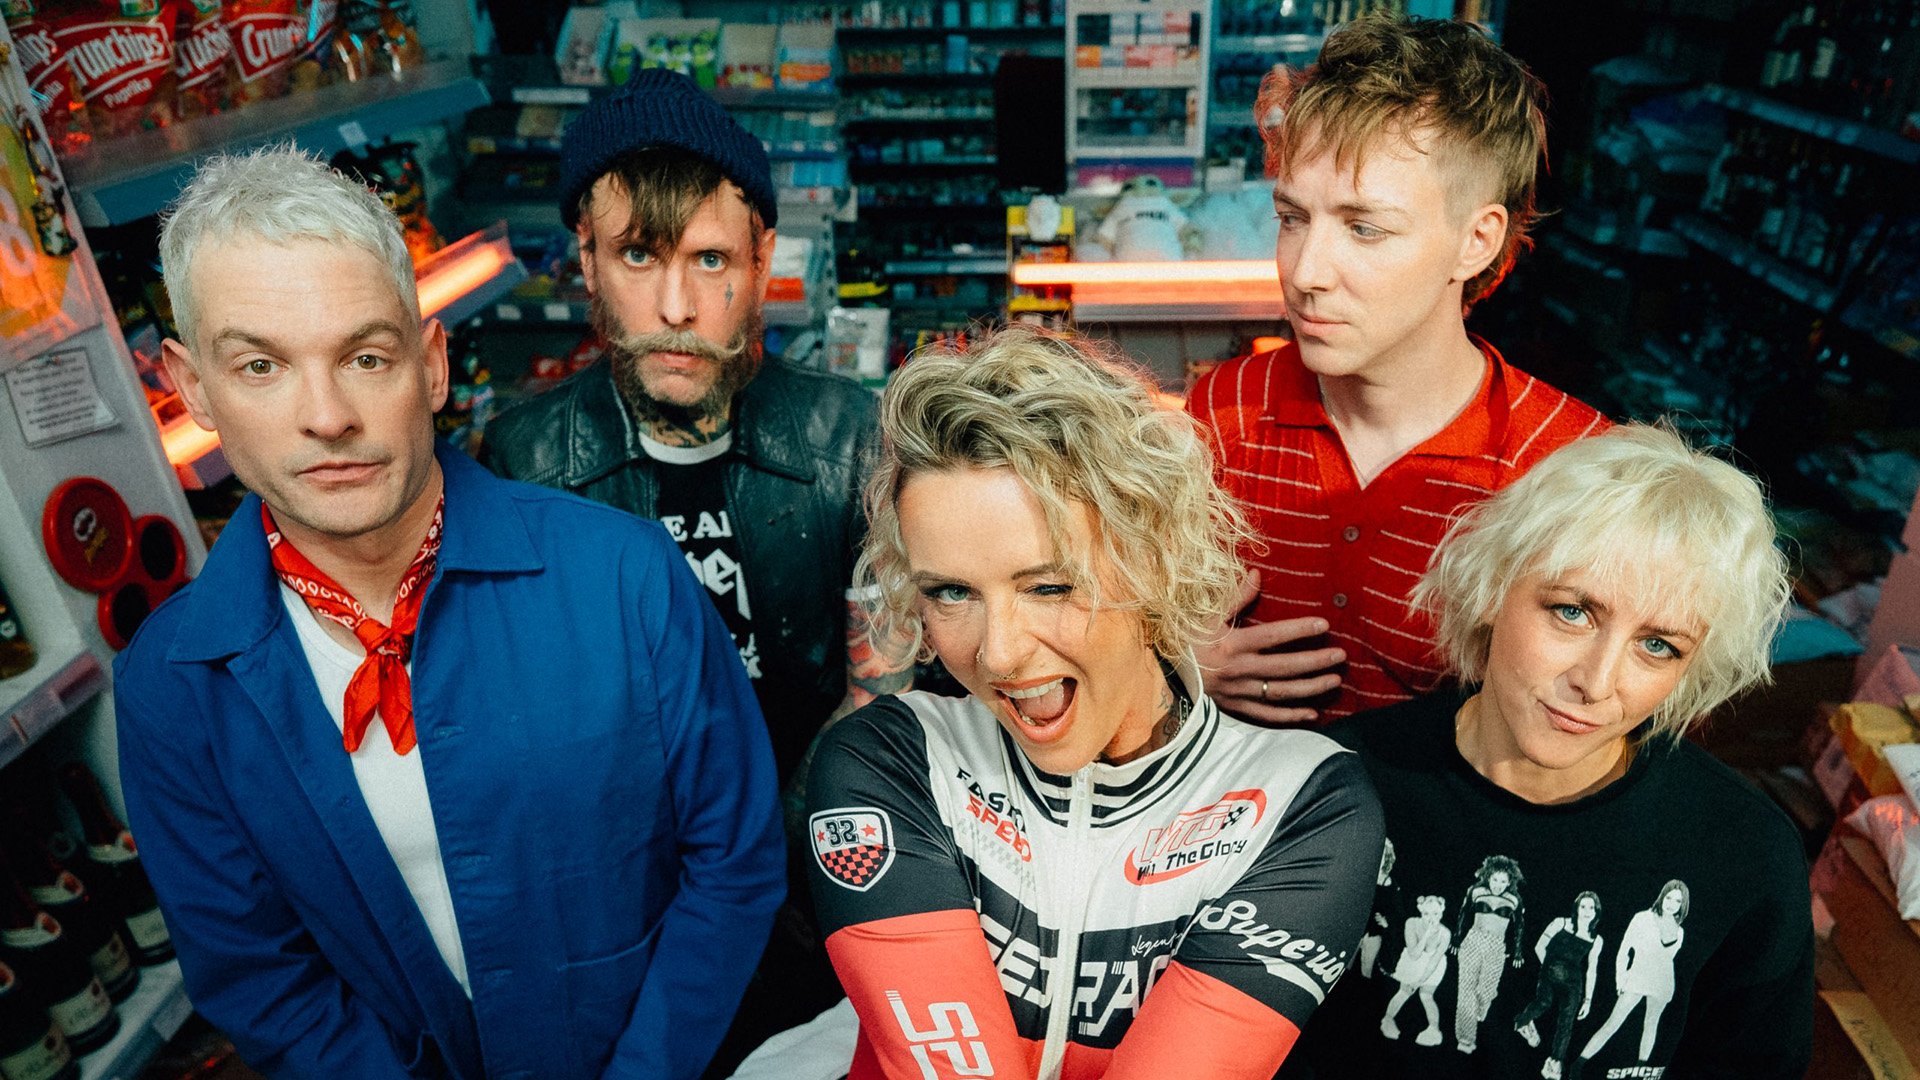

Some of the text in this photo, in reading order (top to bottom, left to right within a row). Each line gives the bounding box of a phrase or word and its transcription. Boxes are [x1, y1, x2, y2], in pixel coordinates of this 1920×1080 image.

[65, 27, 165, 87] runchips
[824, 816, 860, 848] 32
[1166, 851, 1197, 870] The
[1200, 840, 1248, 861] Glory
[1608, 1067, 1666, 1080] SPICE
